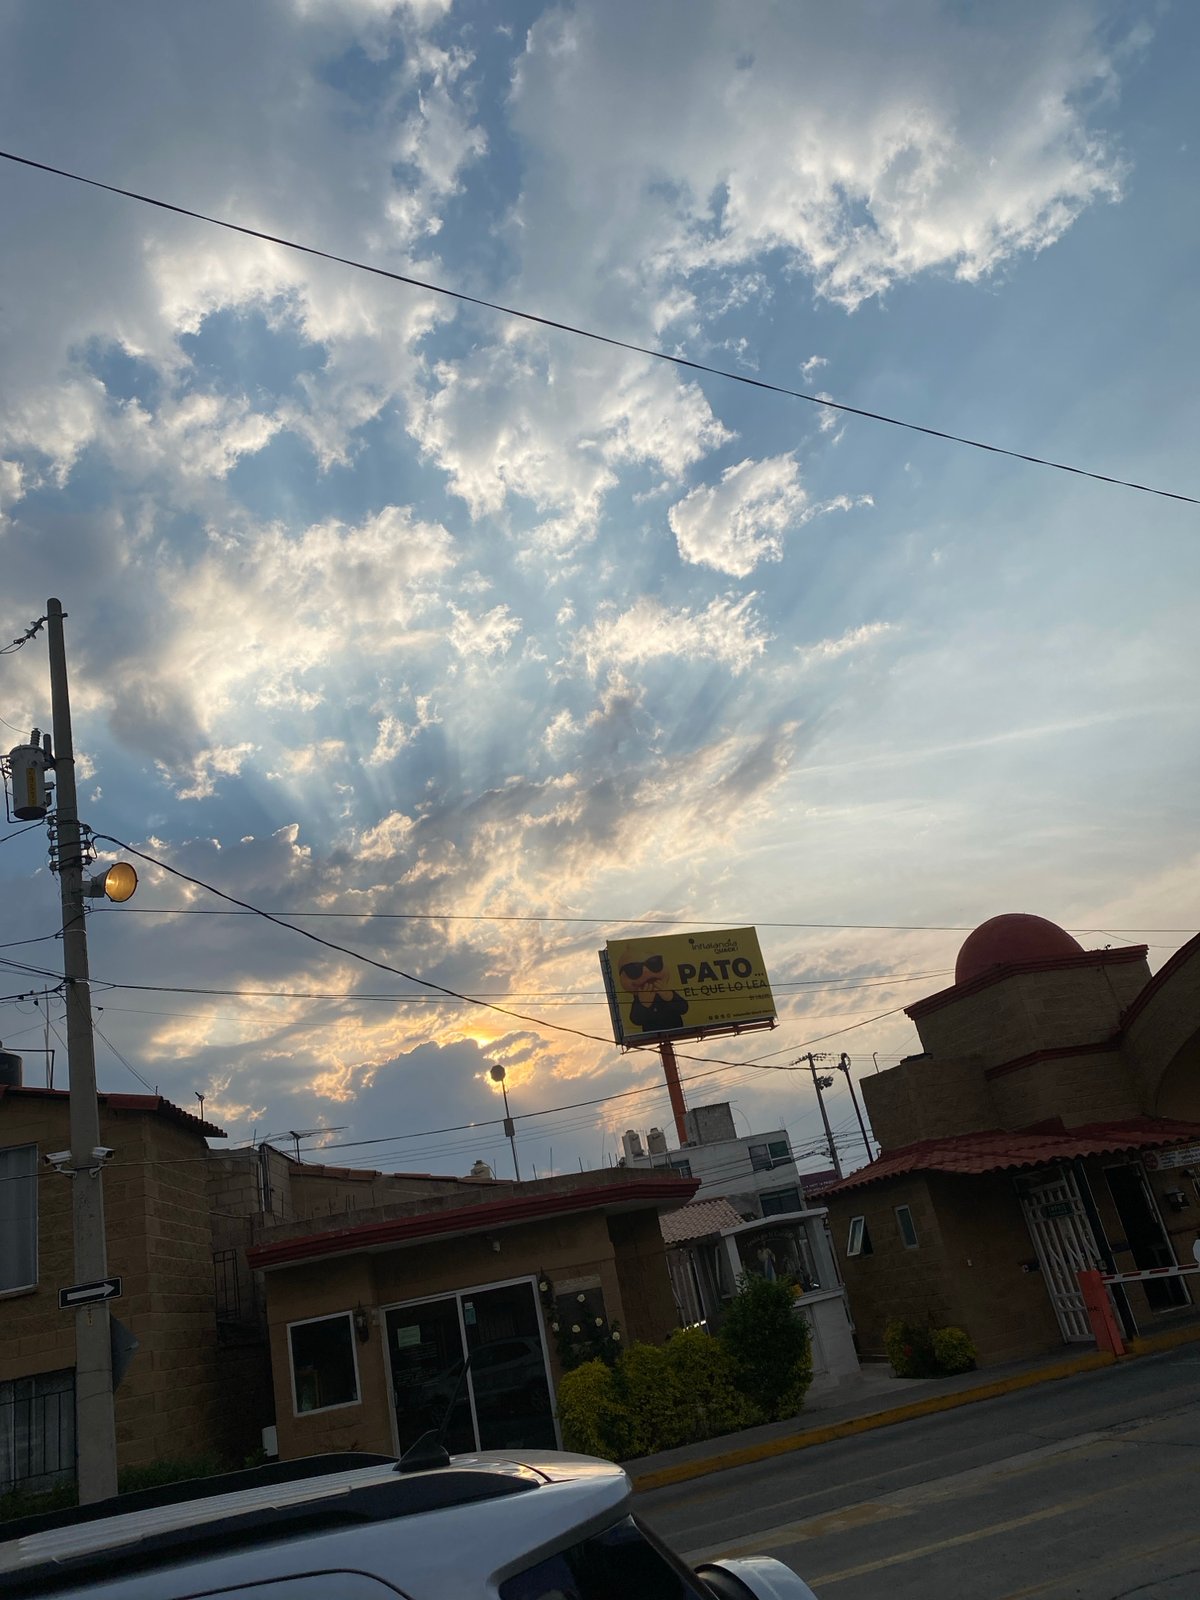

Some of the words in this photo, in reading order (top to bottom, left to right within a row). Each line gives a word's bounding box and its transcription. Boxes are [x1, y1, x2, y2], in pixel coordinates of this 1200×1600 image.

[684, 987, 698, 997] EL
[700, 983, 725, 996] QUE
[728, 981, 743, 992] LO
[746, 979, 768, 990] LEA
